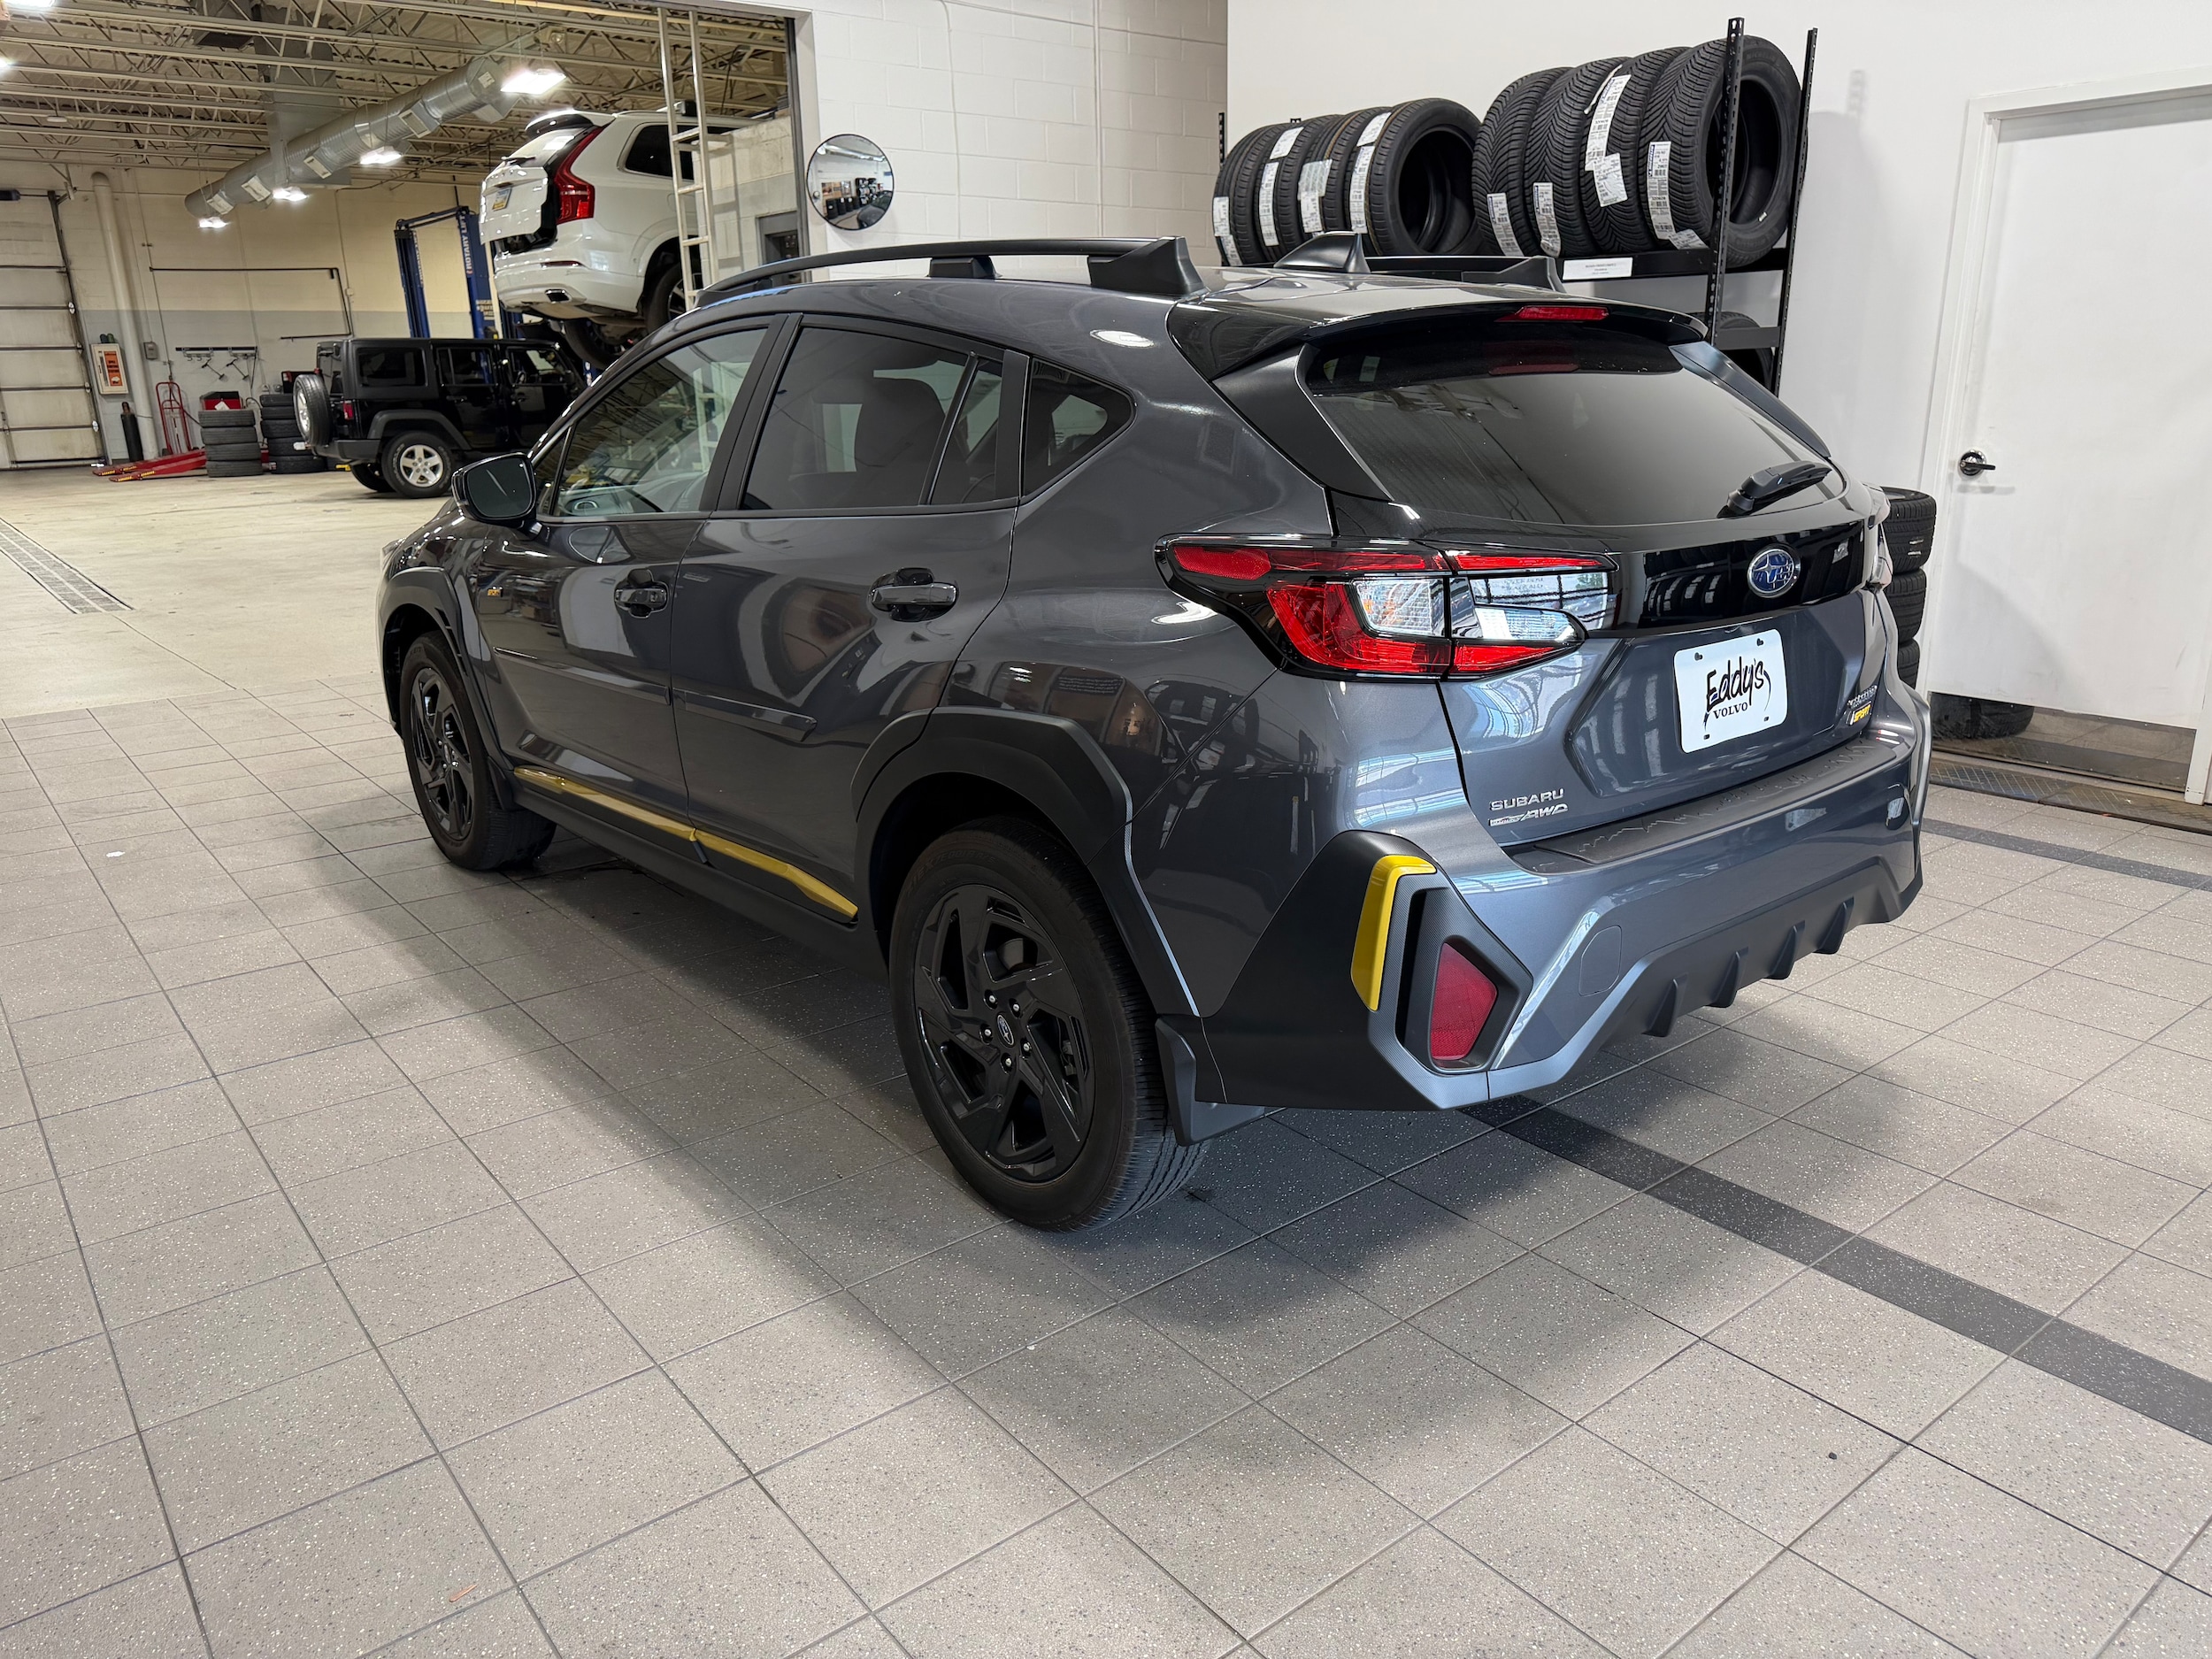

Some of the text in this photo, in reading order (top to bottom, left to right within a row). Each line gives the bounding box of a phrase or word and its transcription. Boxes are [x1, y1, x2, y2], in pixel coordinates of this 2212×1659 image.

[458, 214, 473, 271] ROTARY LIFT
[1706, 656, 1765, 713] Eddy's
[1713, 702, 1748, 719] VOLVO
[1490, 787, 1565, 811] SUBARU
